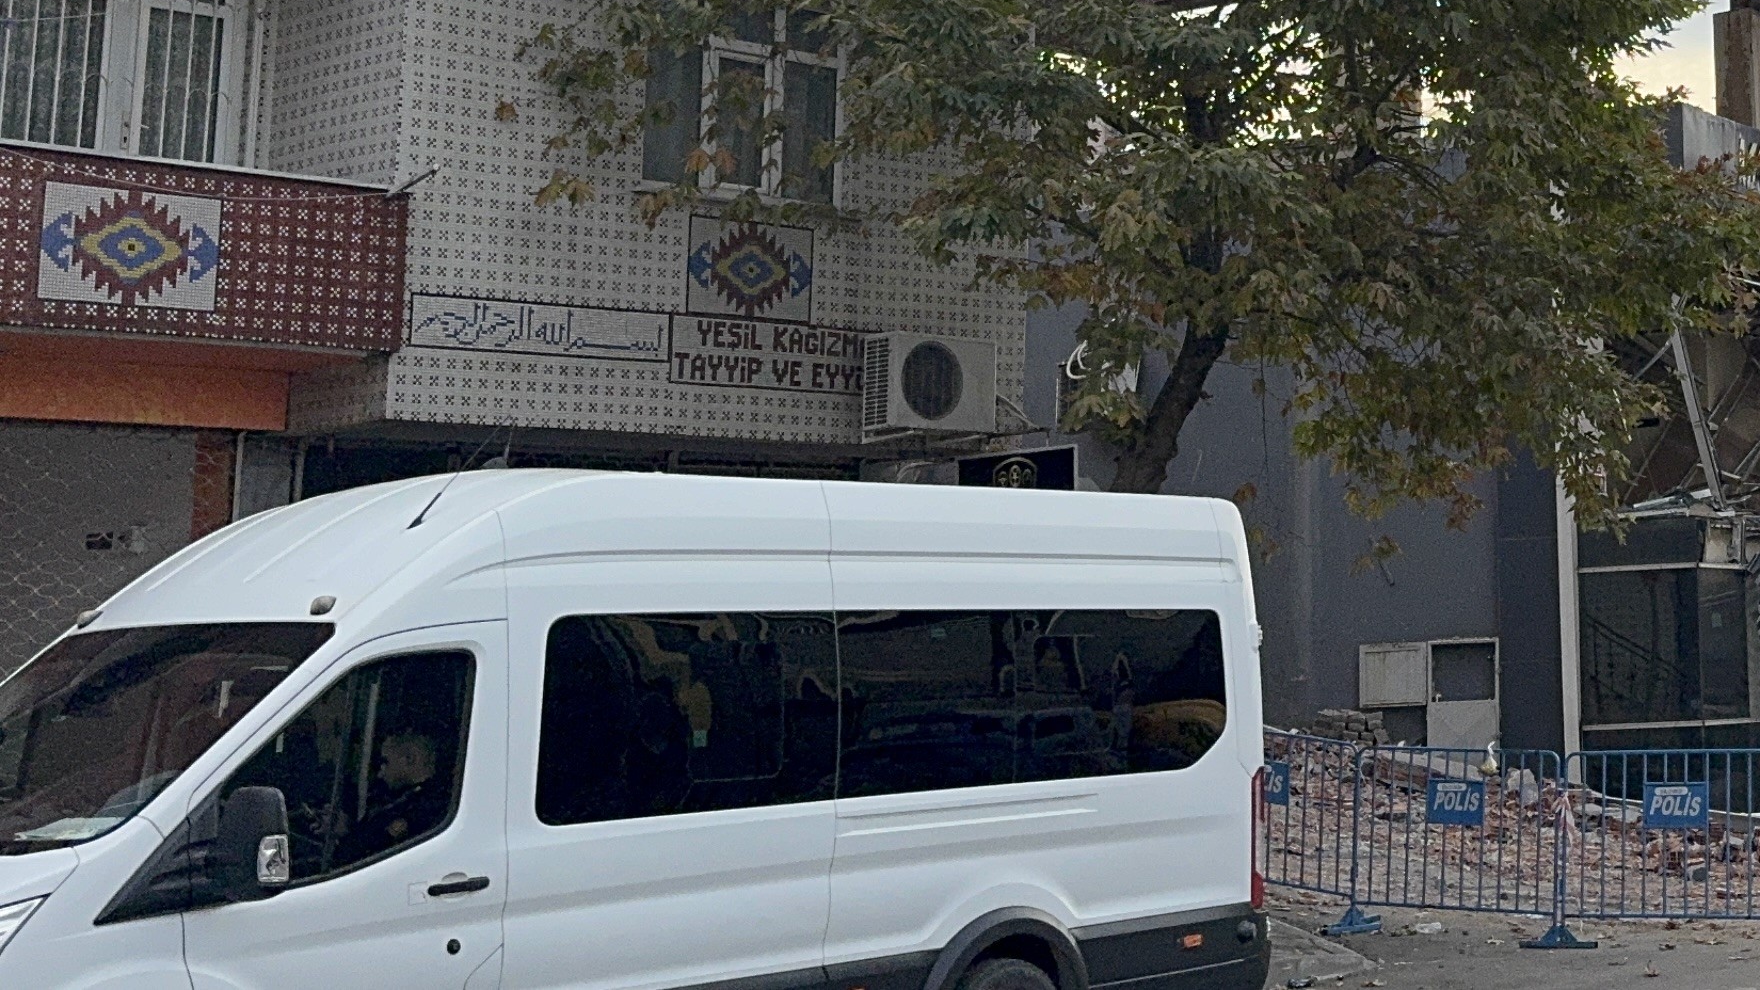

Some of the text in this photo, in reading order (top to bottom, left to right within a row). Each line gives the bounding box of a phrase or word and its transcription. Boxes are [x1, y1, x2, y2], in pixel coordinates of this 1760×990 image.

[772, 359, 801, 387] VE
[1434, 787, 1480, 811] POLİS
[1649, 792, 1702, 817] POLİS
